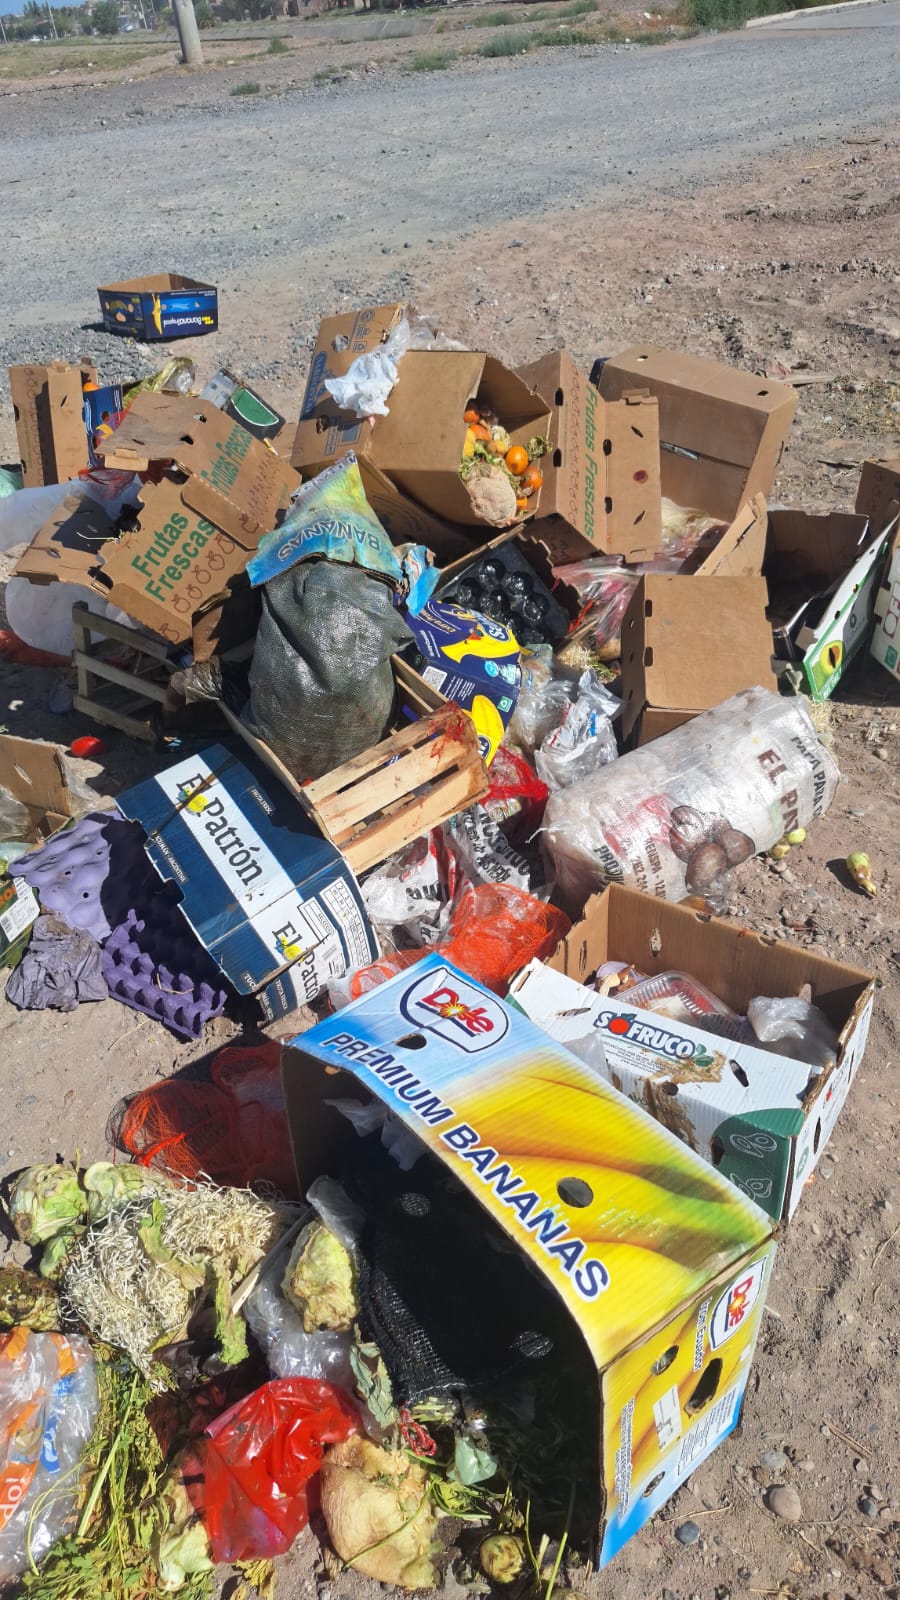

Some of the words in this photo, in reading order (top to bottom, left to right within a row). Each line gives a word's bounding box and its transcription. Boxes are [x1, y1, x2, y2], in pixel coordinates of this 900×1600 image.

[585, 384, 598, 452] Frutas
[584, 453, 598, 539] Frescas
[131, 512, 189, 578] Frutas
[144, 518, 216, 602] Frescas
[277, 519, 381, 561] BANANAS
[757, 749, 788, 786] EL
[203, 796, 263, 886] Patrón
[644, 838, 663, 874] RENSPA
[272, 921, 303, 947] El
[420, 987, 495, 1033] Dole
[593, 1011, 696, 1059] SOFRUCO
[322, 1034, 455, 1125] PREMIUM
[442, 1124, 609, 1298] BANANAS
[729, 1275, 754, 1327] Dole
